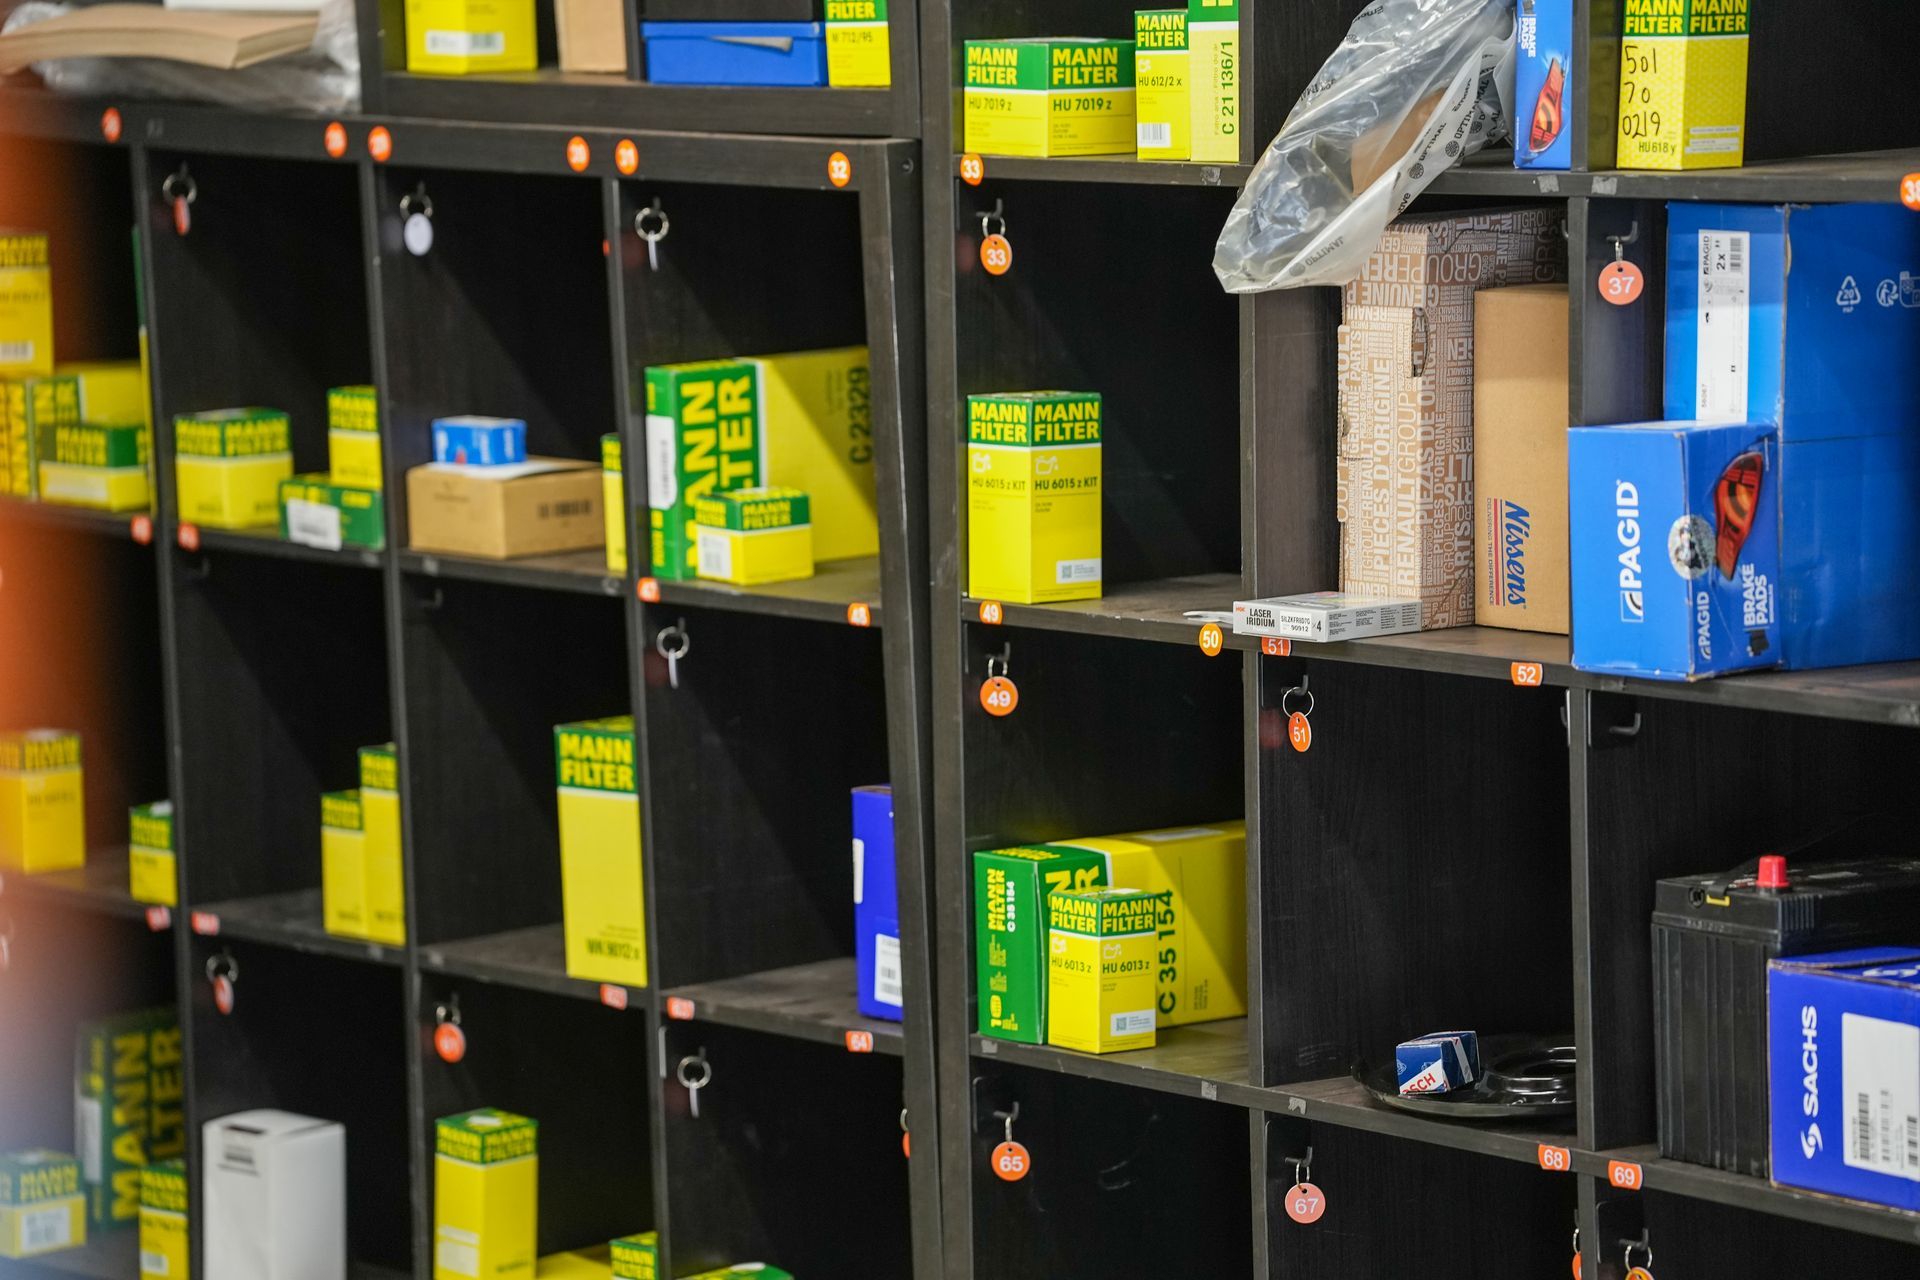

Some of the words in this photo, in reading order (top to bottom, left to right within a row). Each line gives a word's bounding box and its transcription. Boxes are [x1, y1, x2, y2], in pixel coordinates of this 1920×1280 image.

[828, 1, 876, 19] FILTER
[1626, 0, 1683, 15] MANN
[1690, 0, 1747, 14] MANN
[1137, 15, 1185, 30] MANN
[1625, 15, 1683, 33] FILTER
[1690, 15, 1746, 33] FILTER
[1137, 31, 1185, 47] FILTER
[1521, 17, 1529, 50] PADS
[1528, 17, 1536, 58] BRAKE
[968, 47, 1018, 66] MANN
[1053, 47, 1118, 66] MANN
[1221, 41, 1234, 89] 136/1
[968, 65, 1018, 85] FILTER
[1053, 65, 1118, 85] FILTER
[1138, 76, 1149, 86] HU
[1151, 76, 1174, 87] 612/2
[1176, 78, 1182, 86] x
[969, 97, 980, 109] HU
[984, 98, 1006, 111] 7019
[1053, 99, 1071, 111] HU
[1076, 98, 1104, 111] 7019
[1106, 101, 1112, 110] z
[1222, 97, 1234, 116] 21
[1222, 123, 1234, 135] C
[1638, 142, 1651, 152] HU
[1652, 141, 1668, 152] 618
[831, 160, 848, 178] 32
[964, 160, 981, 179] 33
[987, 248, 1006, 266] 33
[1608, 276, 1635, 295] 37
[1843, 289, 1854, 299] 20
[1350, 331, 1361, 381] PARTS
[971, 402, 1027, 423] MANN
[1034, 402, 1099, 422] MANN
[1374, 359, 1390, 480] D'ORIGINE
[971, 421, 1028, 443] FILTER
[1034, 421, 1099, 442] FILTER
[1417, 411, 1435, 441] DE
[850, 446, 872, 464] C
[1434, 412, 1446, 494] D'ORIGINE
[972, 478, 984, 488] HU
[985, 479, 1004, 490] 6015
[1012, 480, 1026, 491] KIT
[1034, 479, 1050, 490] HU
[1052, 477, 1074, 489] 6015
[1077, 480, 1082, 488] z
[1083, 476, 1097, 488] KIT
[1416, 447, 1434, 525] PIEZAS
[743, 500, 790, 515] MANN
[743, 514, 790, 529] FILTER
[1374, 488, 1390, 570] PIECES
[1433, 498, 1444, 555] PIECES
[1616, 482, 1642, 588] PAGID
[1505, 500, 1530, 605] Nissens
[1742, 563, 1756, 626] BRAKE
[1755, 574, 1768, 624] PADS
[982, 604, 999, 622] 49
[1246, 616, 1275, 627] IRIDIUM
[1249, 608, 1272, 618] LASER
[1697, 591, 1711, 647] PAGID
[1202, 631, 1219, 648] 50
[1268, 638, 1284, 655] 51
[1518, 666, 1536, 683] 52
[987, 690, 1011, 707] 49
[1293, 726, 1306, 743] 51
[559, 734, 632, 762] MANN
[560, 759, 634, 789] FILTER
[987, 868, 997, 930] MANN
[996, 870, 1006, 931] FILTER
[1051, 895, 1096, 917] MANN
[1102, 899, 1154, 918] MANN
[1051, 912, 1096, 933] FILTER
[1102, 914, 1154, 933] FILTER
[1156, 889, 1175, 941] 154
[1051, 957, 1062, 968] HU
[1064, 959, 1085, 972] 6013
[1102, 962, 1118, 973] HU
[1119, 960, 1143, 972] 6013
[1145, 961, 1150, 970] z
[1158, 949, 1176, 983] 35
[1158, 996, 1176, 1014] C
[850, 1034, 868, 1049] 64
[1802, 1005, 1819, 1118] SACHS
[1000, 1156, 1024, 1172] 65
[1543, 1150, 1563, 1168] 68
[1614, 1168, 1635, 1186] 69
[1295, 1197, 1318, 1214] 67
